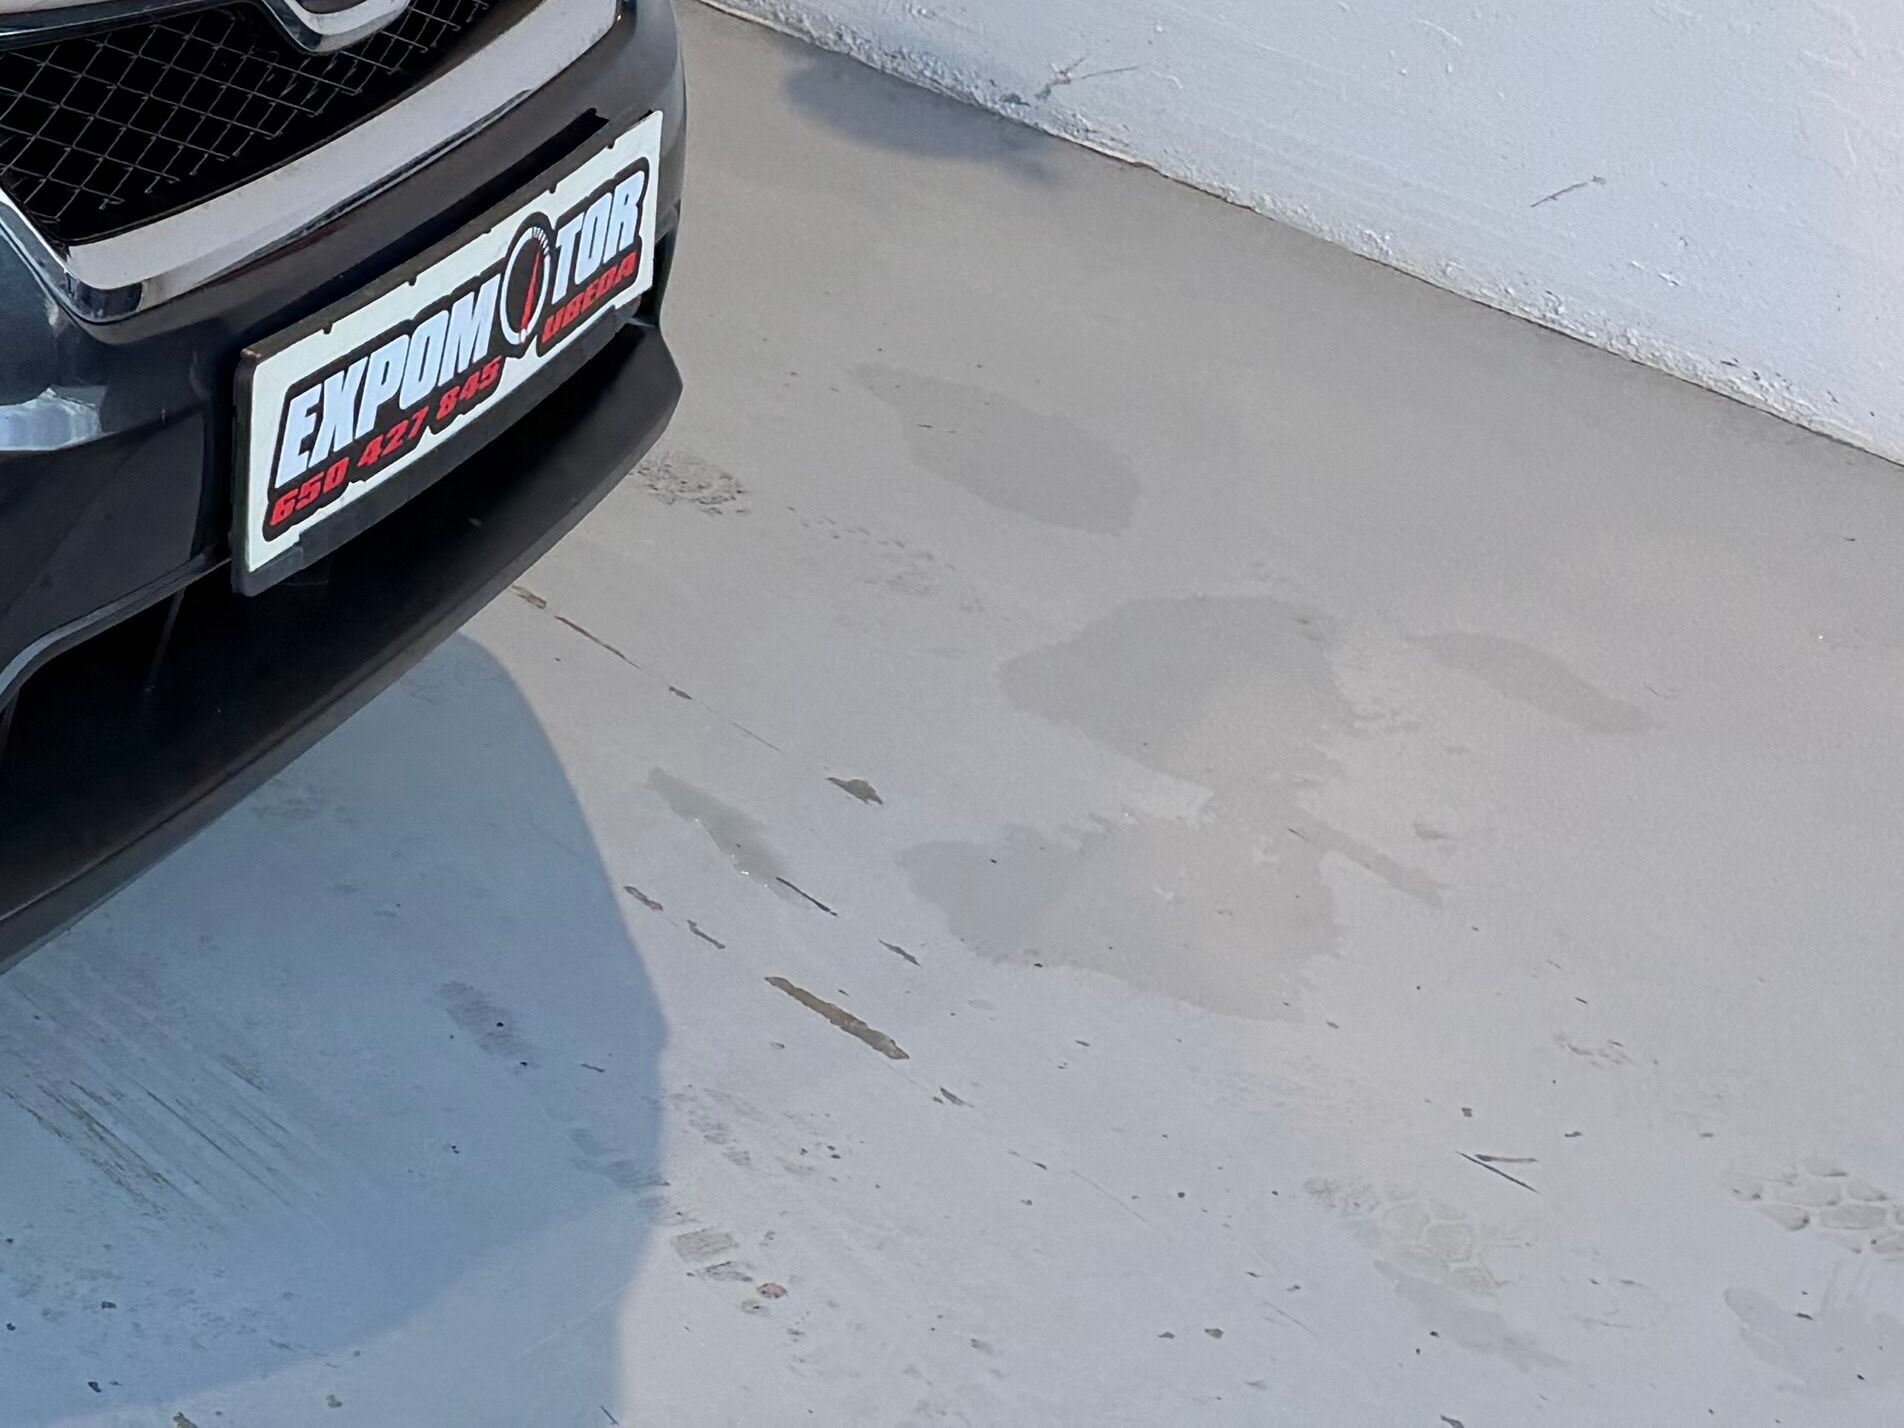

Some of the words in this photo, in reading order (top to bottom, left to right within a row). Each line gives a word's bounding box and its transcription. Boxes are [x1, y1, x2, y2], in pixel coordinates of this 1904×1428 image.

[542, 252, 638, 344] UBEDA
[270, 456, 350, 527] 650
[358, 405, 430, 468] 427
[437, 355, 502, 421] 845
